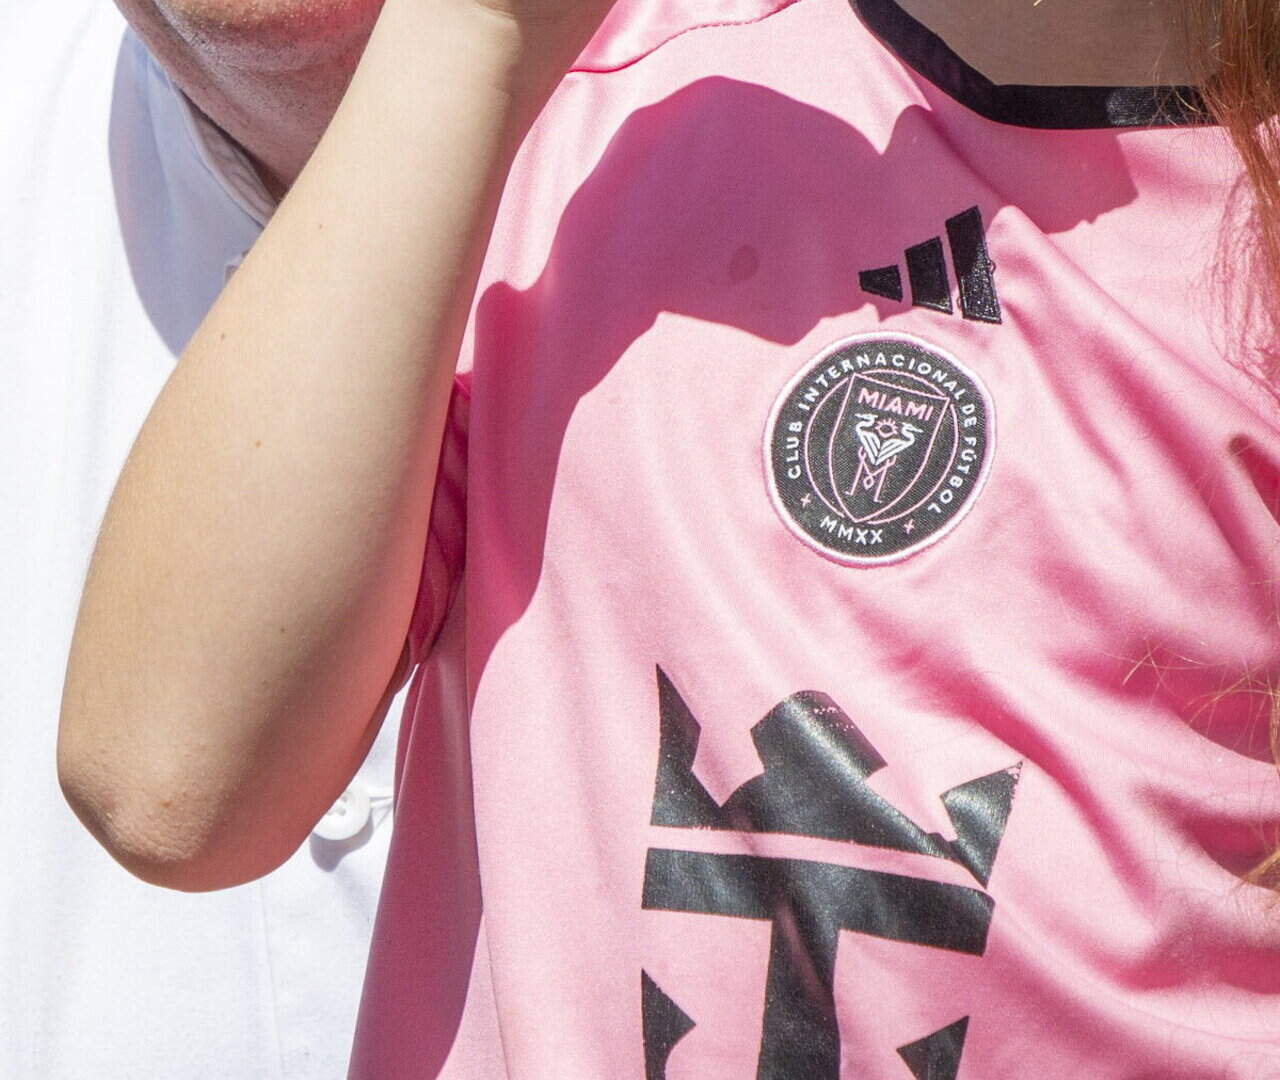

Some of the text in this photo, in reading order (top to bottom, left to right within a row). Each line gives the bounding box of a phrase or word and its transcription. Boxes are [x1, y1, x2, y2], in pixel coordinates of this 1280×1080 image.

[786, 421, 803, 480] CLUB
[798, 352, 966, 411] INTERNACIONAL
[961, 403, 978, 428] DE
[858, 387, 934, 421] MIAMI
[820, 516, 883, 545] MMXX
